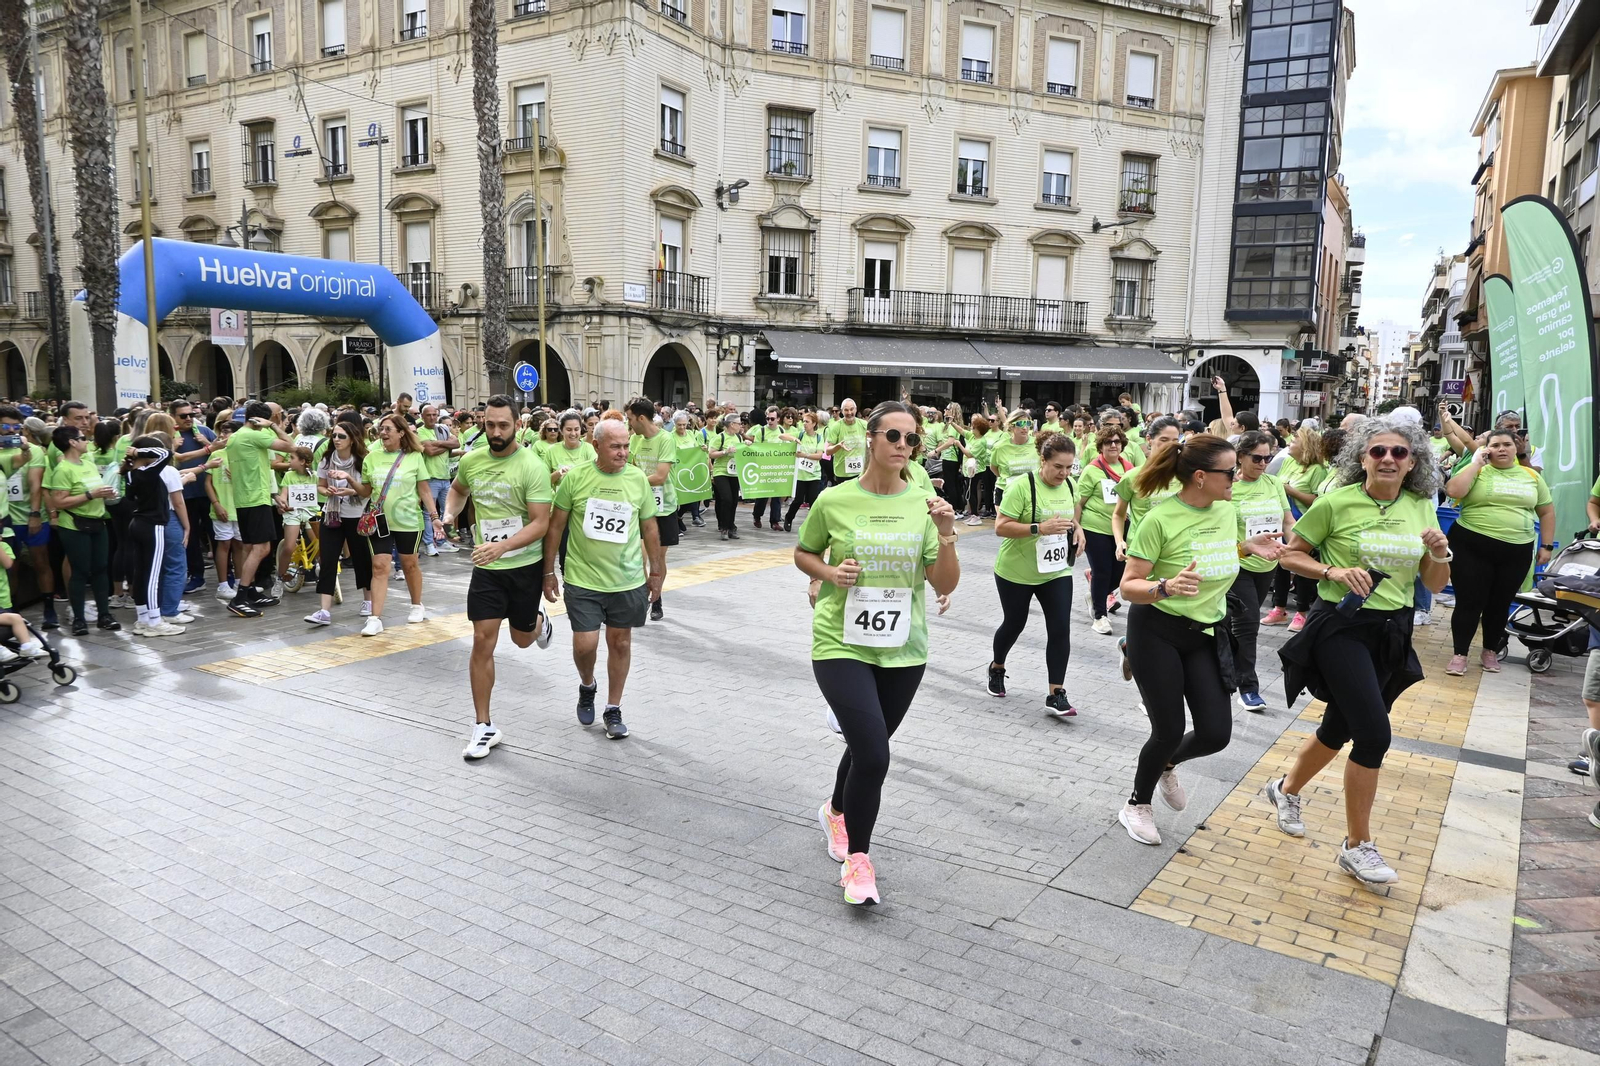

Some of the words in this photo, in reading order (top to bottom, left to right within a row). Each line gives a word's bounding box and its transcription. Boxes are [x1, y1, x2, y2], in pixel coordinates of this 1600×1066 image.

[199, 256, 292, 290] Huelva
[300, 270, 376, 300] original
[114, 355, 147, 368] uelva
[859, 366, 888, 374] RESTAURANTE
[1446, 382, 1460, 390] MC
[801, 460, 814, 469] 412
[8, 485, 20, 495] 6
[295, 492, 316, 502] 438
[654, 496, 661, 506] 3
[593, 515, 626, 534] 362
[855, 530, 871, 540] En
[874, 531, 922, 542] marcha
[1361, 530, 1377, 539] En
[845, 530, 855, 559] ELVA
[855, 543, 905, 557] contra
[908, 544, 919, 557] el
[1191, 541, 1204, 551] En
[1360, 543, 1409, 556] contra
[1044, 547, 1065, 562] 480
[1193, 551, 1232, 564] contra
[1196, 562, 1240, 578] cánce
[855, 610, 901, 631] 467
